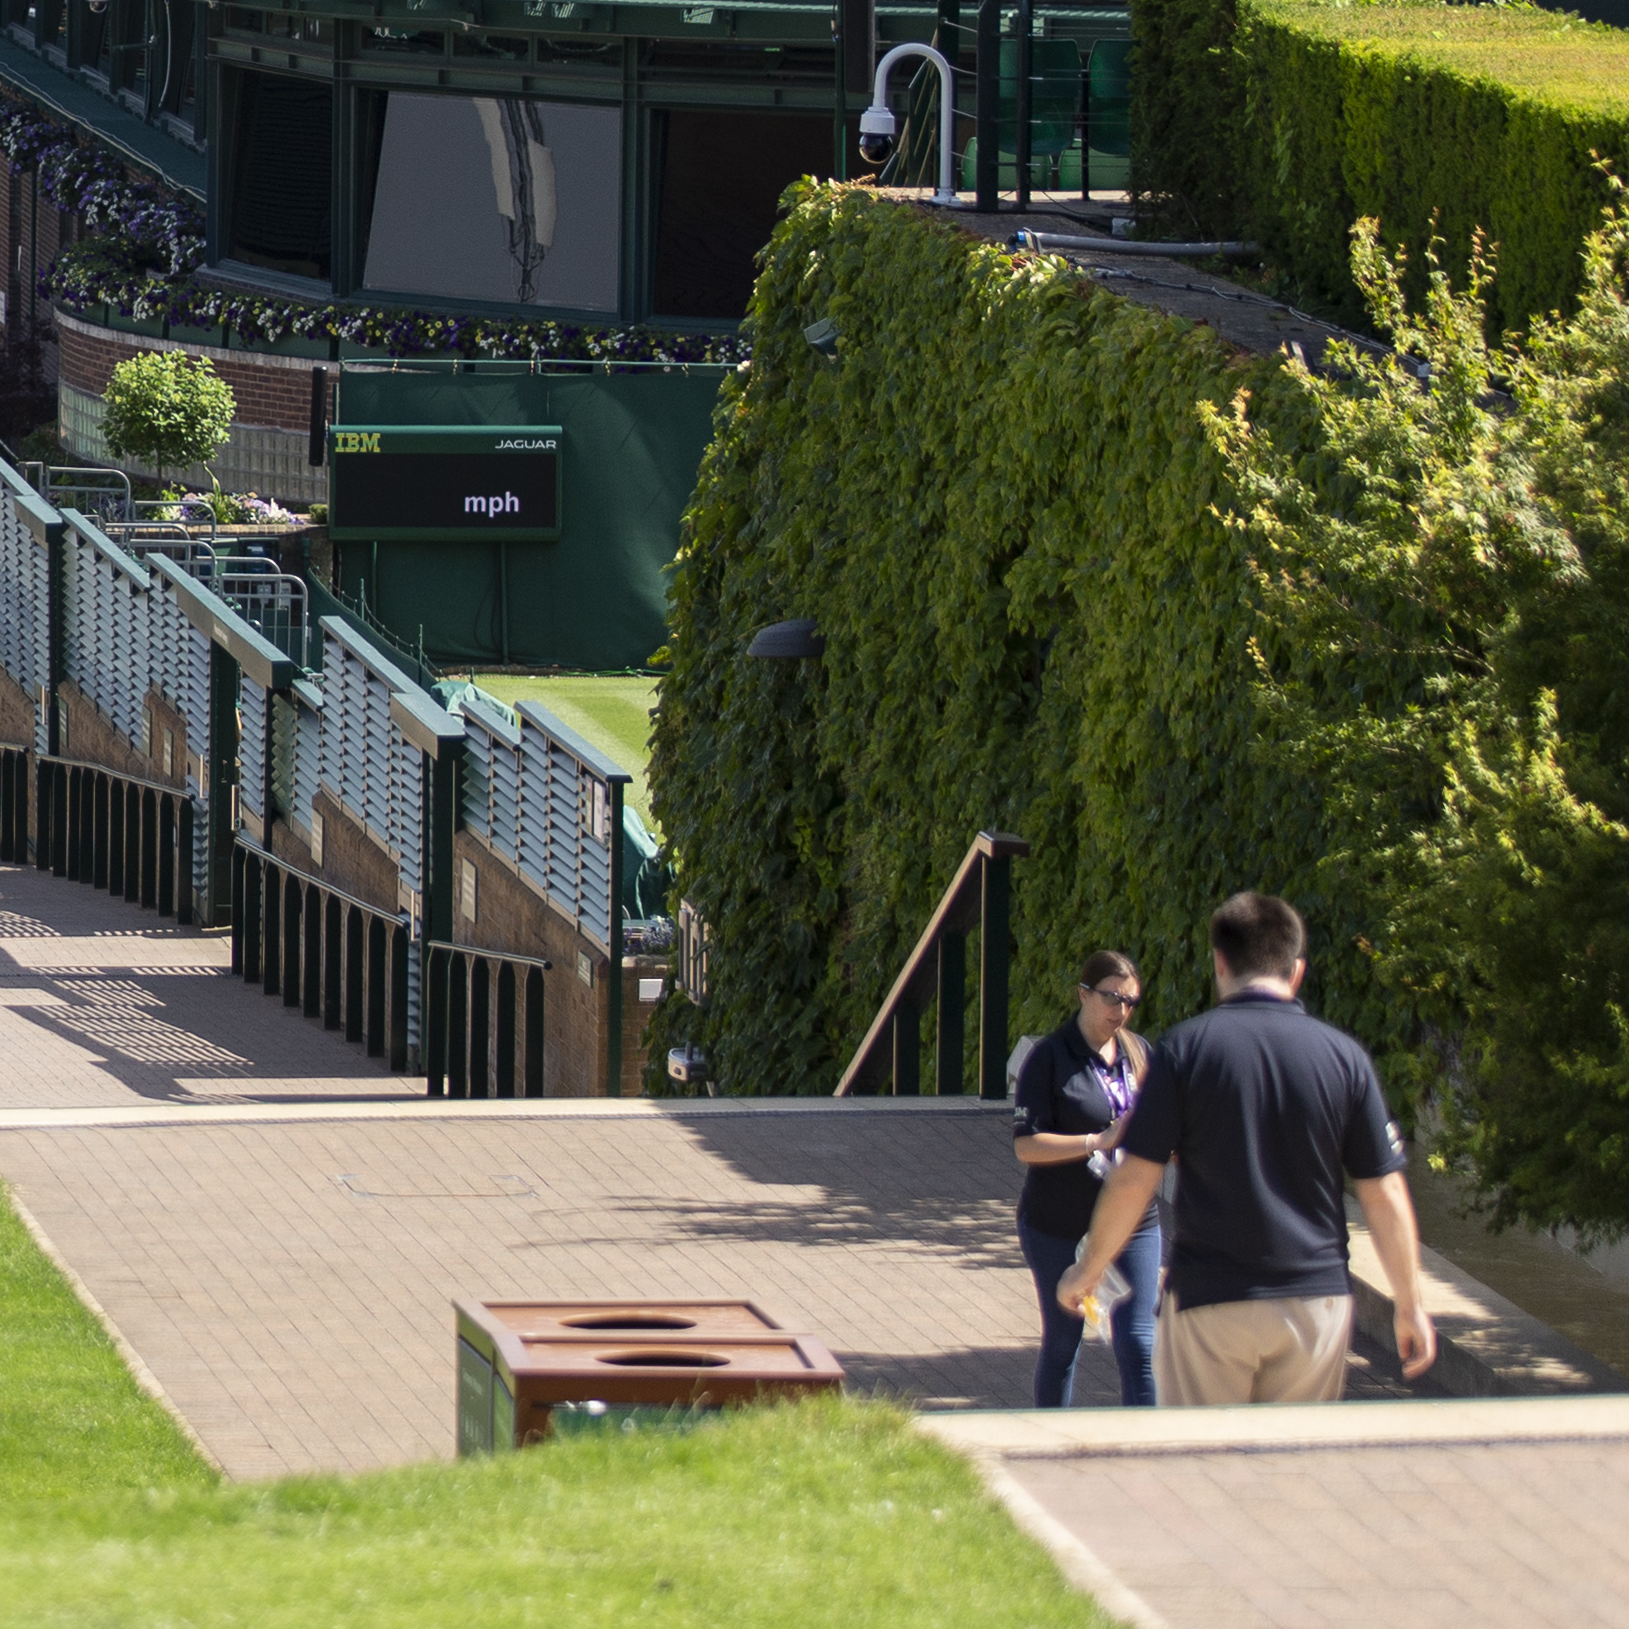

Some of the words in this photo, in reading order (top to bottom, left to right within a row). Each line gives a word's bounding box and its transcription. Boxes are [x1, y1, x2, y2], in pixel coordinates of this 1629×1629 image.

[335, 432, 382, 453] IBM
[495, 439, 557, 449] JAGUAR
[464, 491, 520, 518] mph
